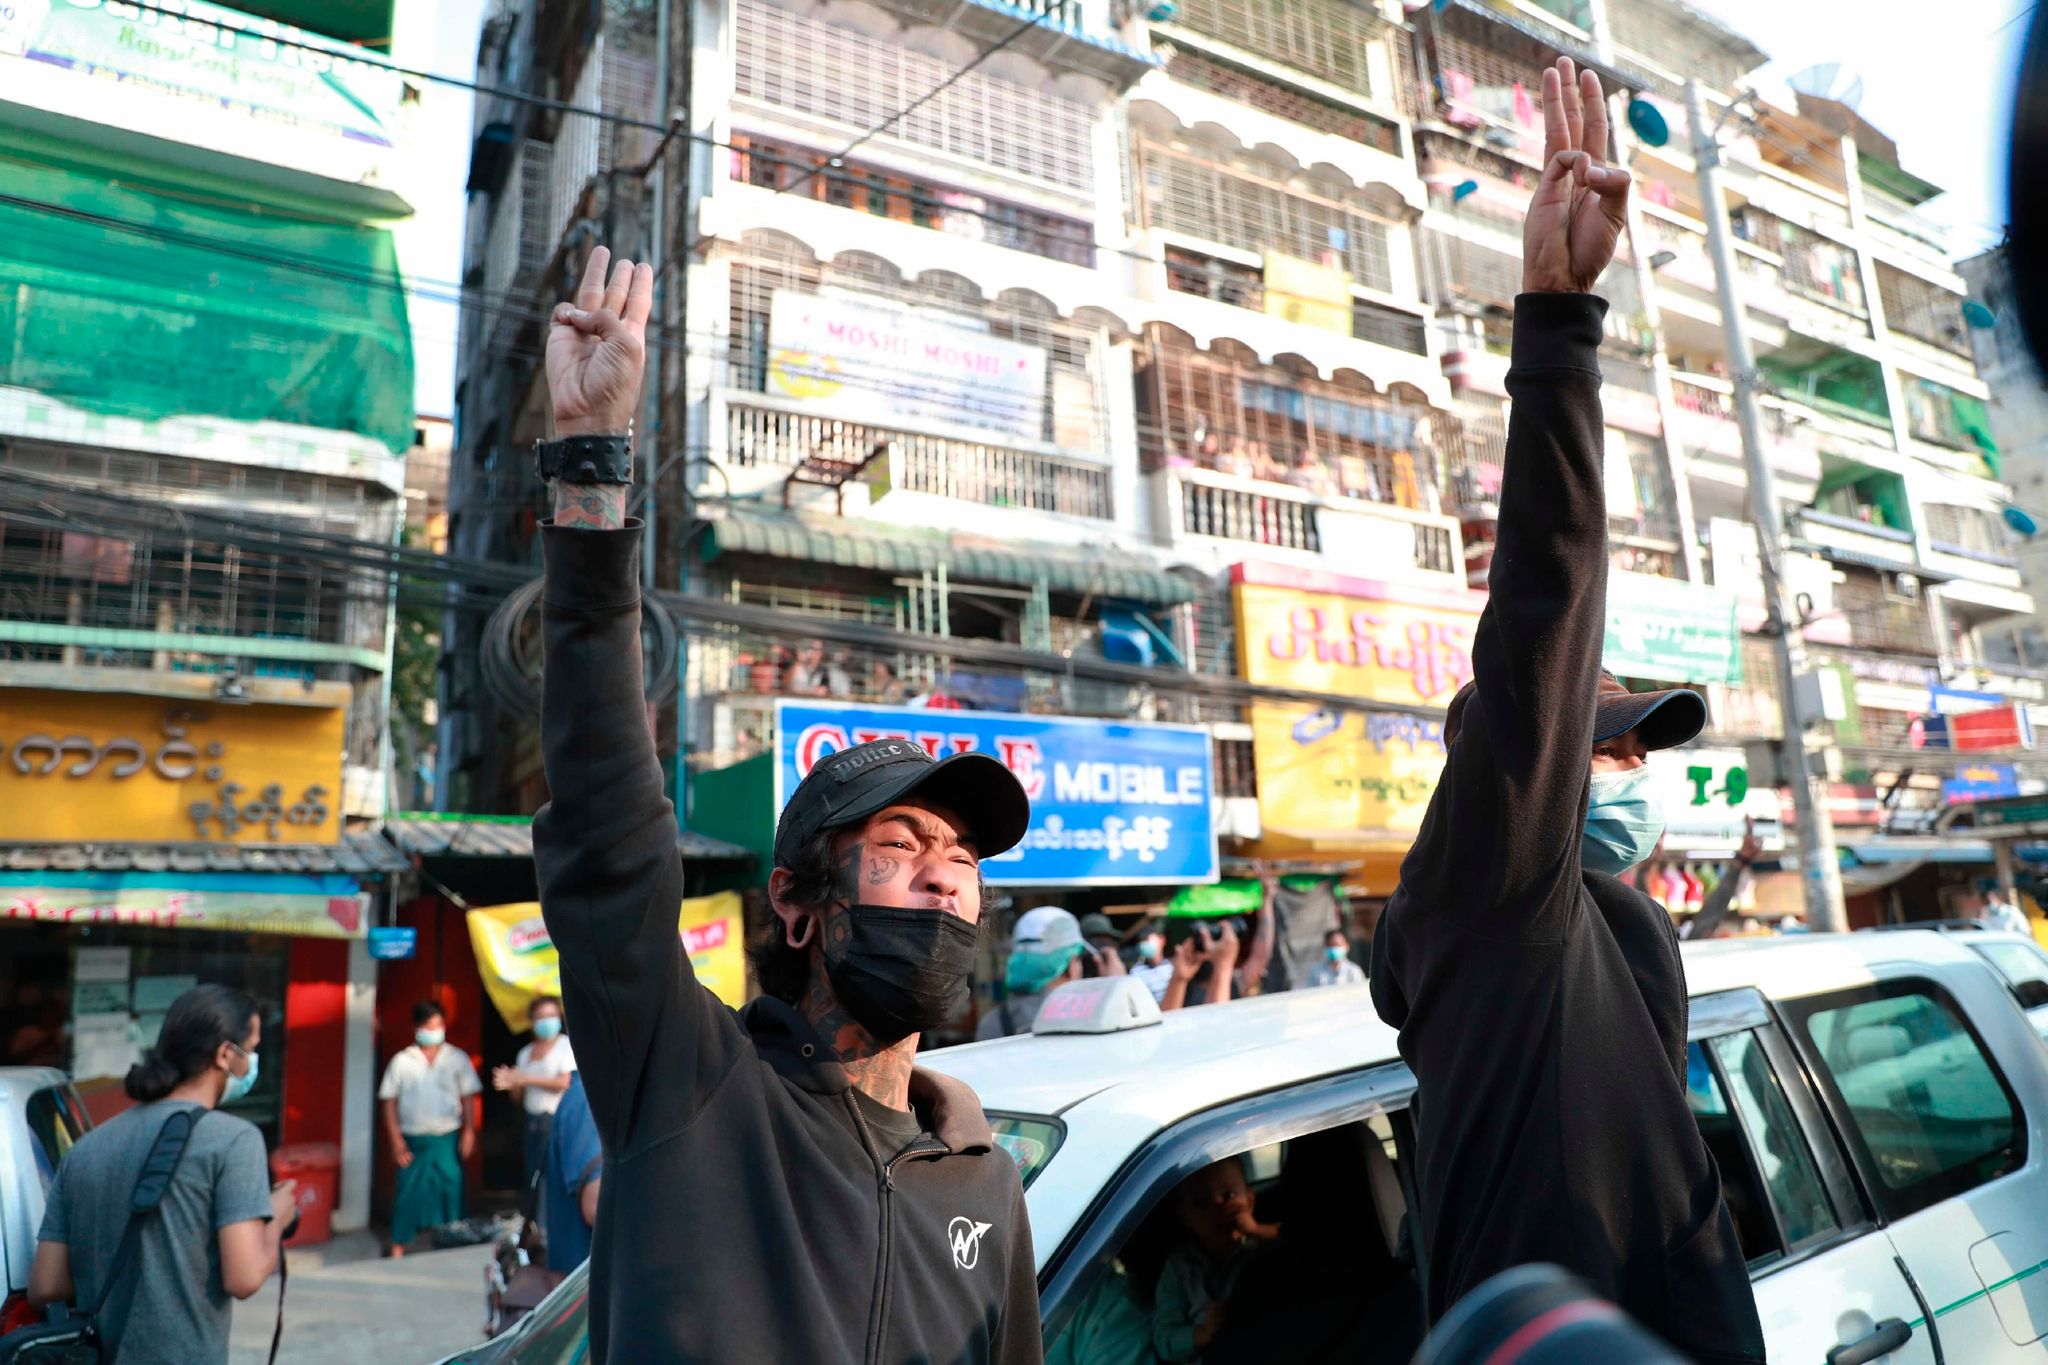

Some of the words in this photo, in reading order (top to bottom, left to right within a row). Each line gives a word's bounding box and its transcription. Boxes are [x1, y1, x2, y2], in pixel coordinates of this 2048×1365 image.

[827, 320, 909, 356] MOSHI
[924, 342, 1001, 375] MOSHI
[1053, 760, 1203, 805] MOBILE
